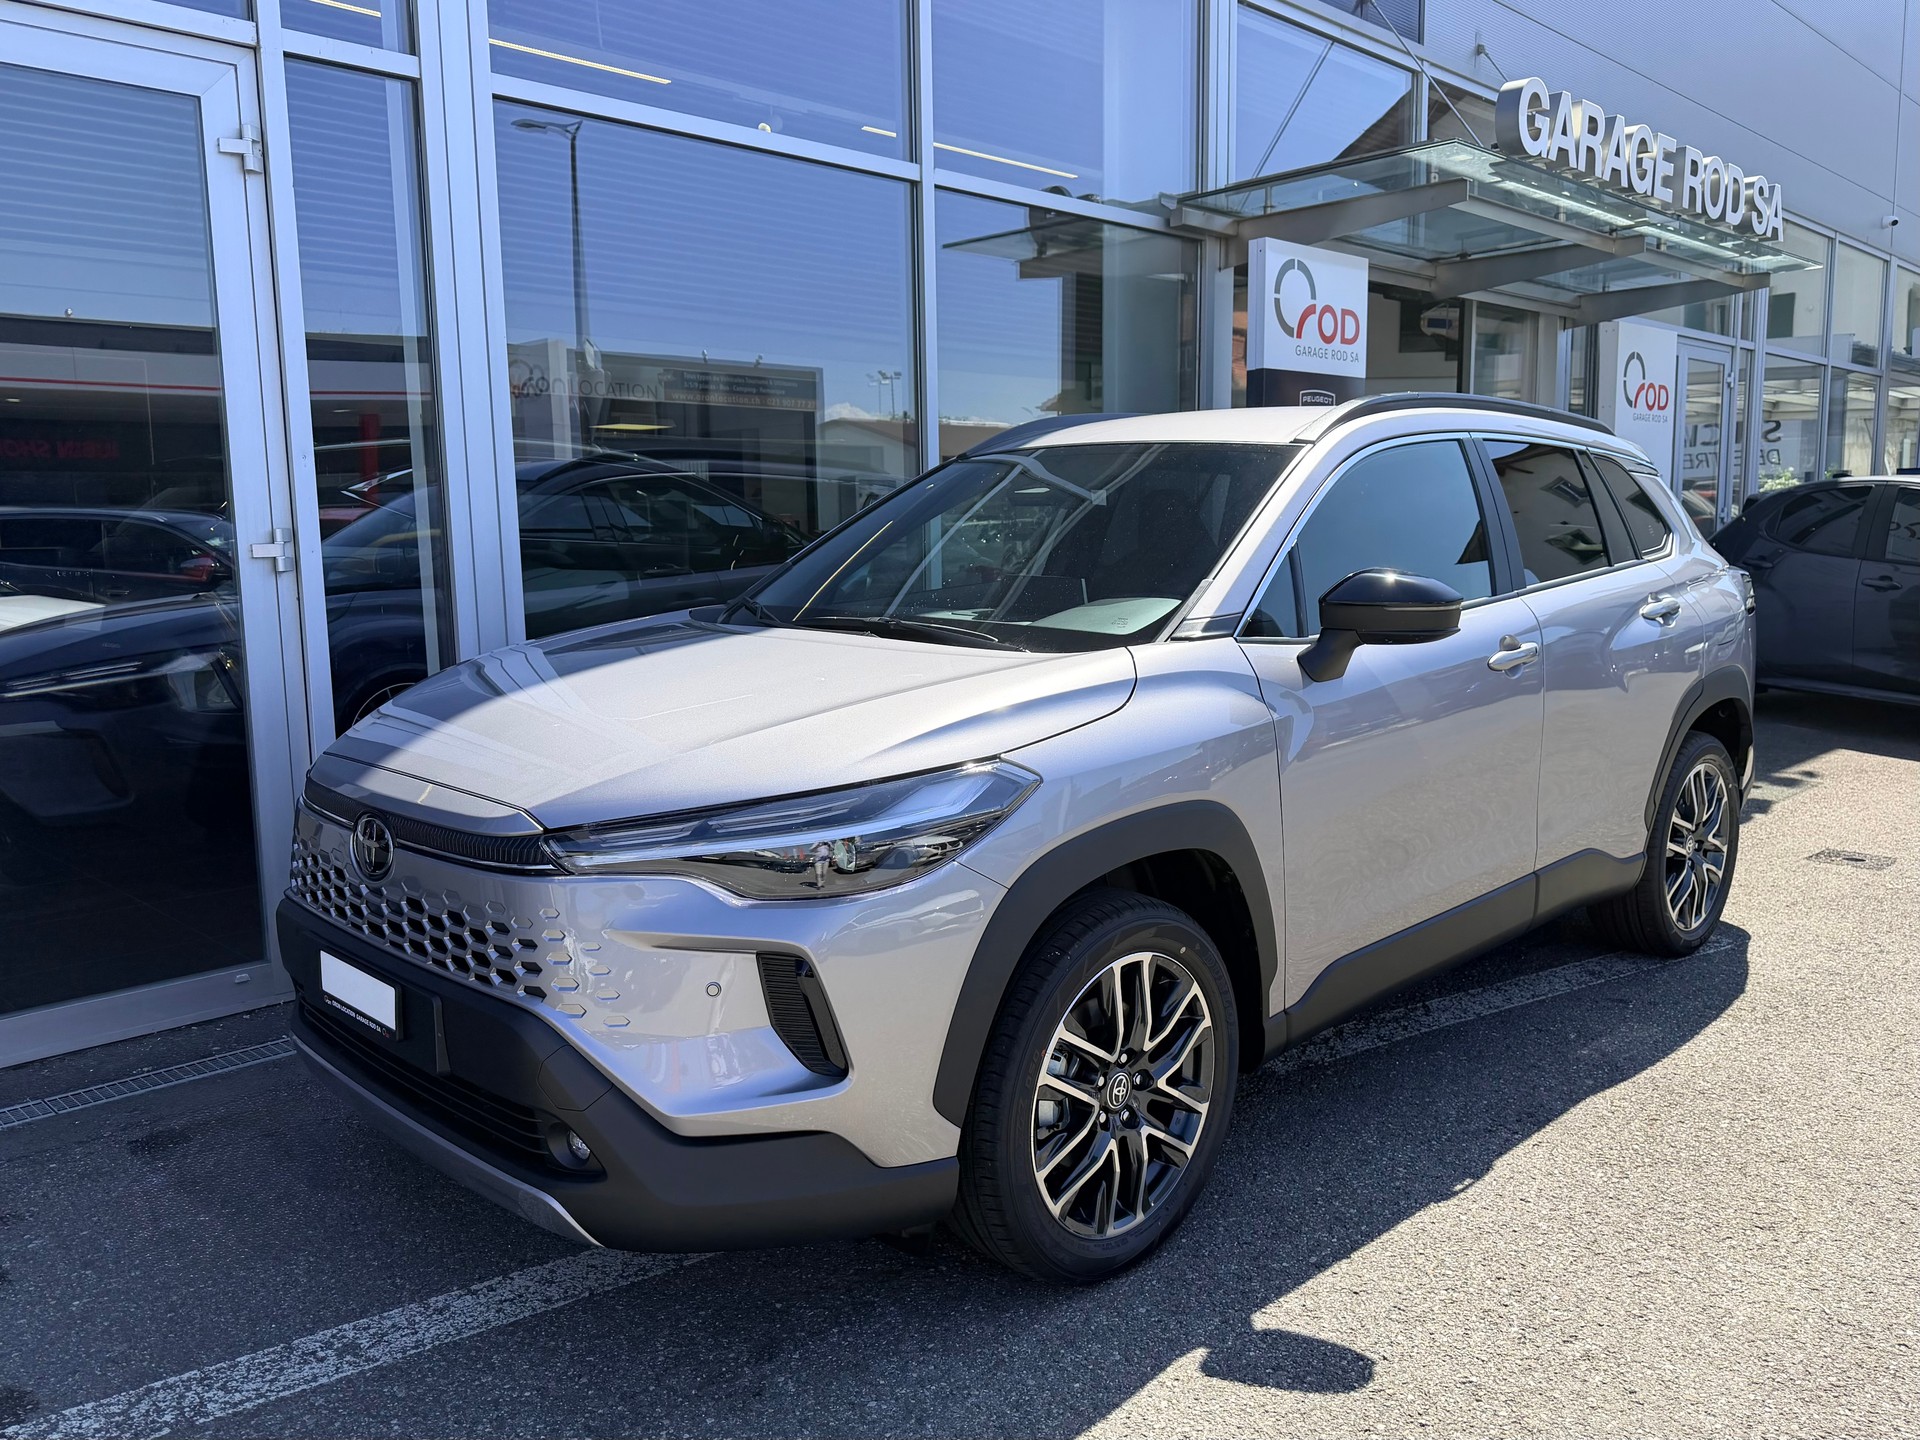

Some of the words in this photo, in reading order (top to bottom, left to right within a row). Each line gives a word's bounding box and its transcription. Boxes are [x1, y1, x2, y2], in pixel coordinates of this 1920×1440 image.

[1517, 76, 1677, 204] GARAGE
[1682, 145, 1745, 227] ROD
[1751, 175, 1784, 242] SA
[1295, 344, 1329, 360] GARAGE
[1331, 349, 1349, 361] ROD
[1350, 354, 1360, 363] SA
[571, 379, 658, 400] LOCATION
[1302, 395, 1333, 404] PEUGEOT
[1632, 412, 1651, 423] GARAGE
[1651, 414, 1661, 423] ROD
[356, 1013, 369, 1026] GARAGE
